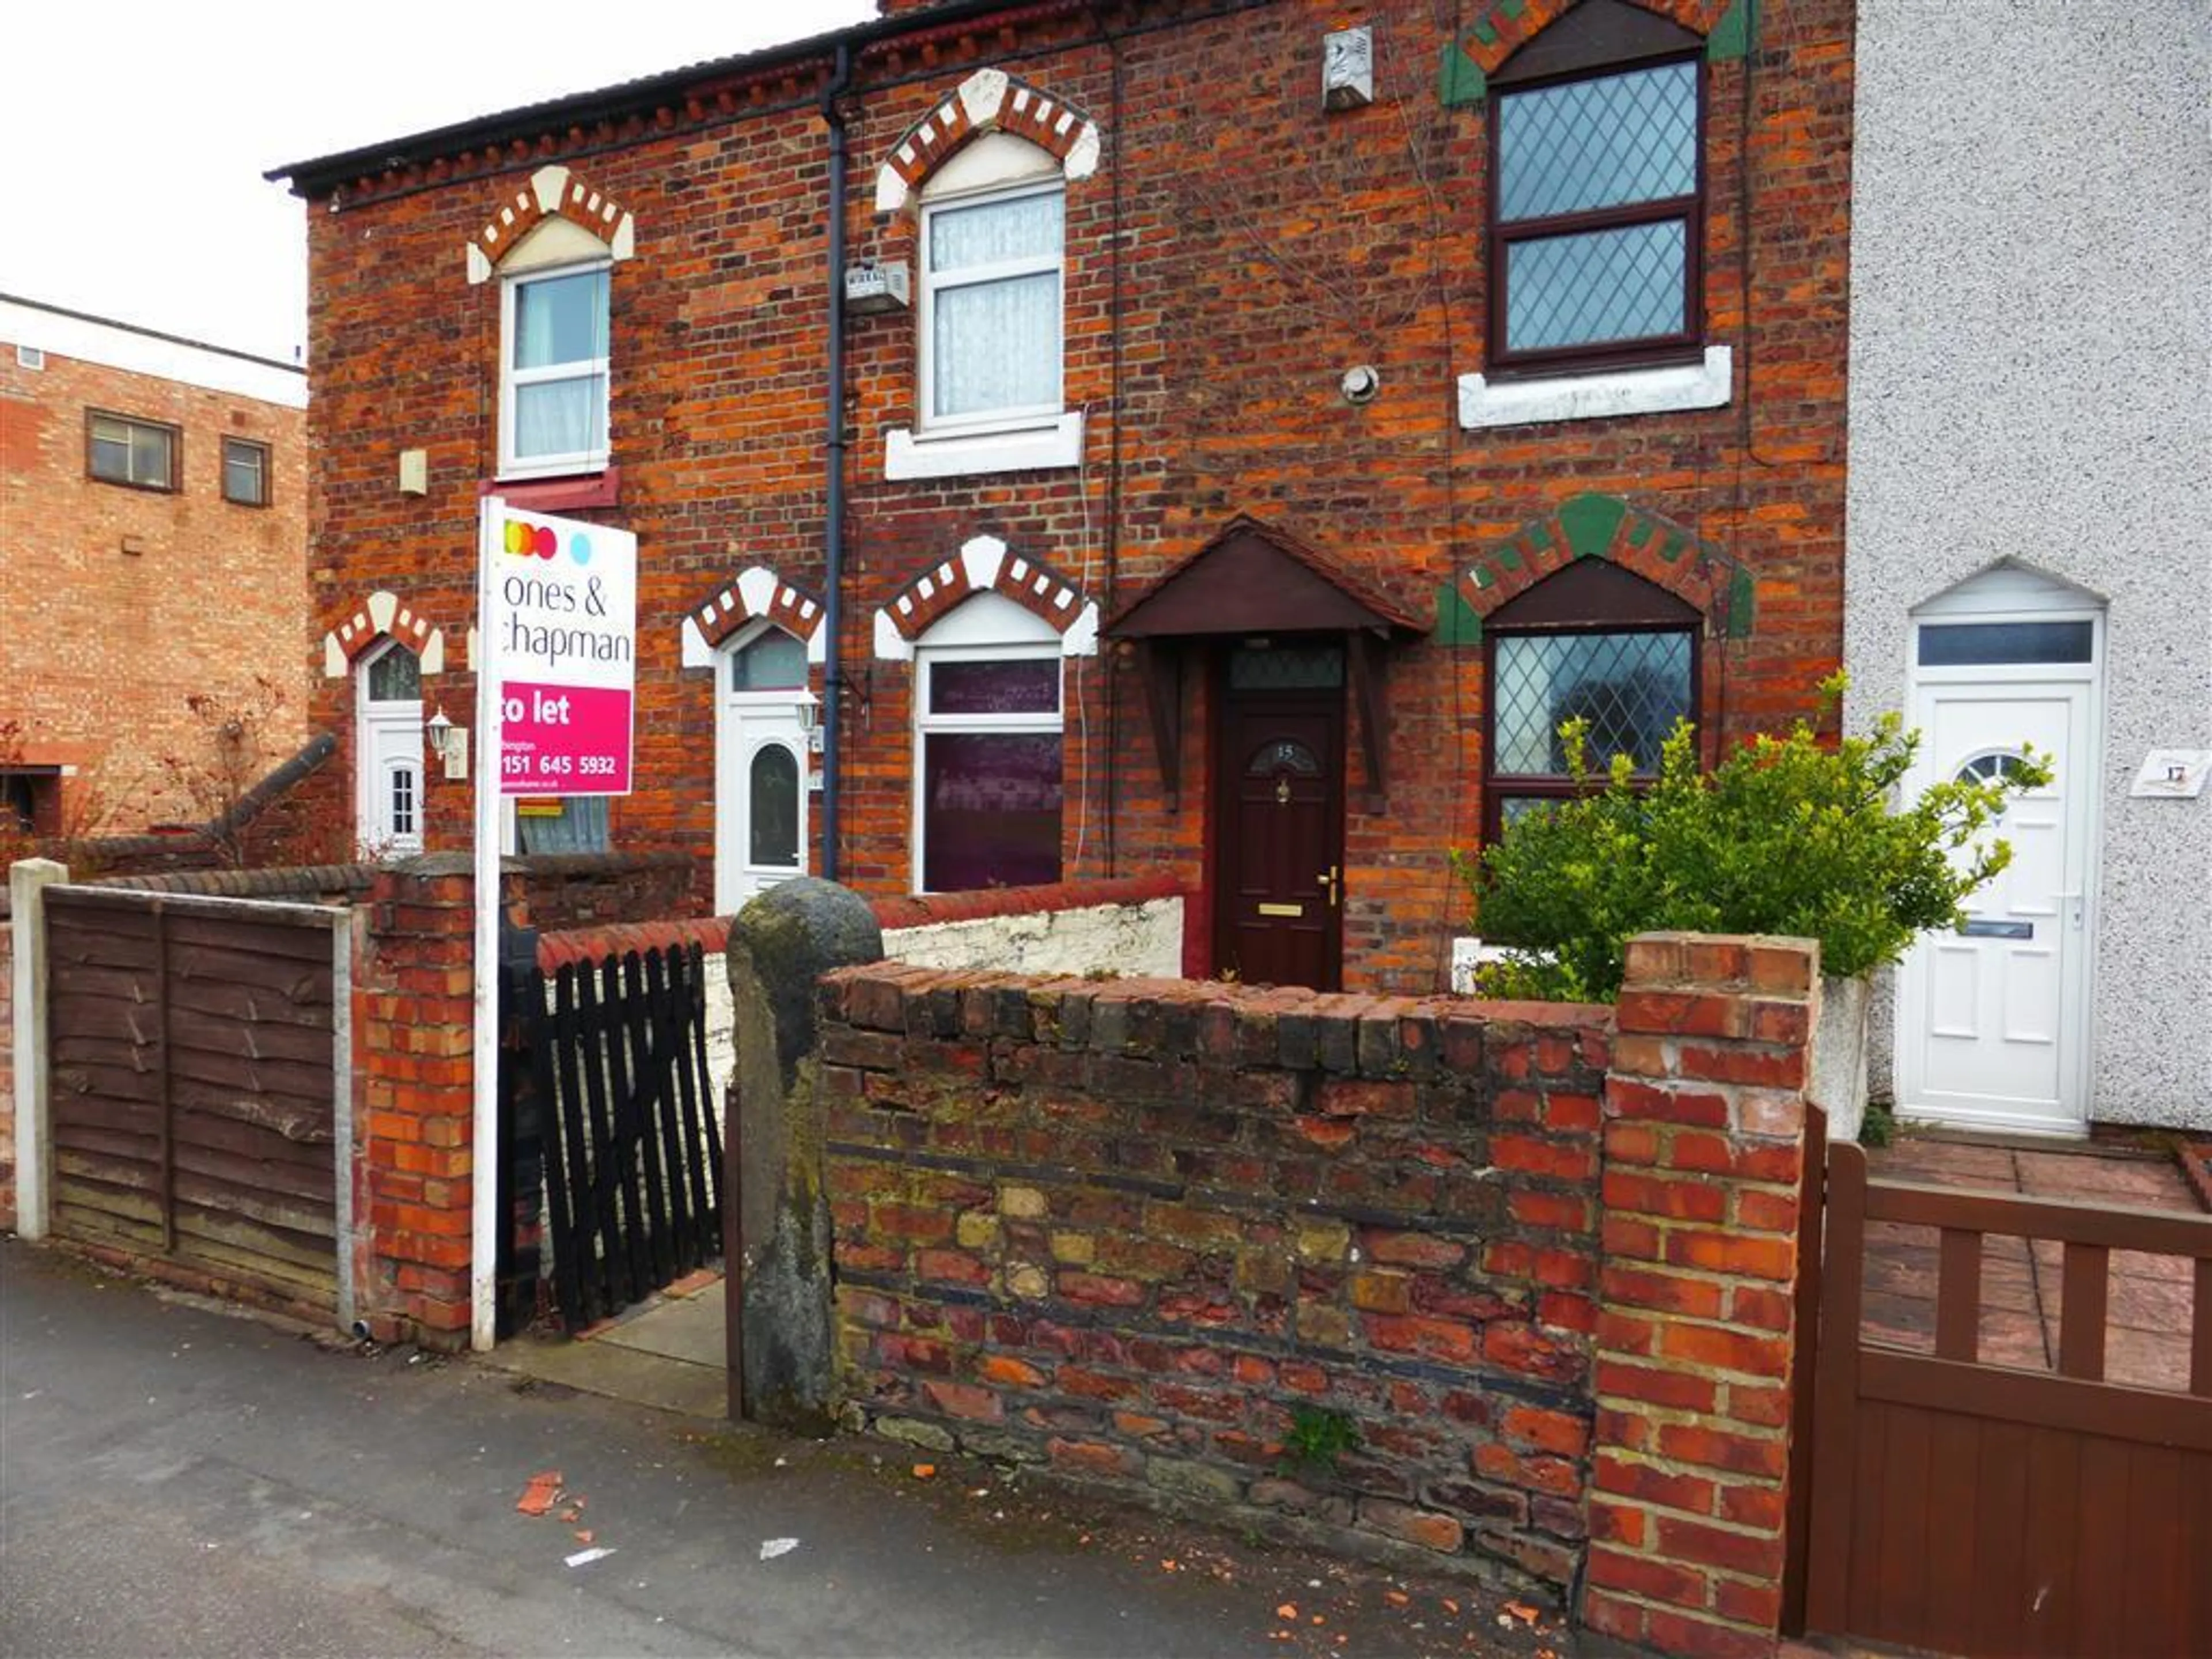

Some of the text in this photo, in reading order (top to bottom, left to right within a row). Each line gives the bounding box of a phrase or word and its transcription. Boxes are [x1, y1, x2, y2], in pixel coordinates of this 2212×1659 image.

[504, 575, 606, 616] ones &
[533, 690, 570, 725] let
[503, 755, 616, 774] 151 645 5932
[1278, 745, 1294, 760] 15
